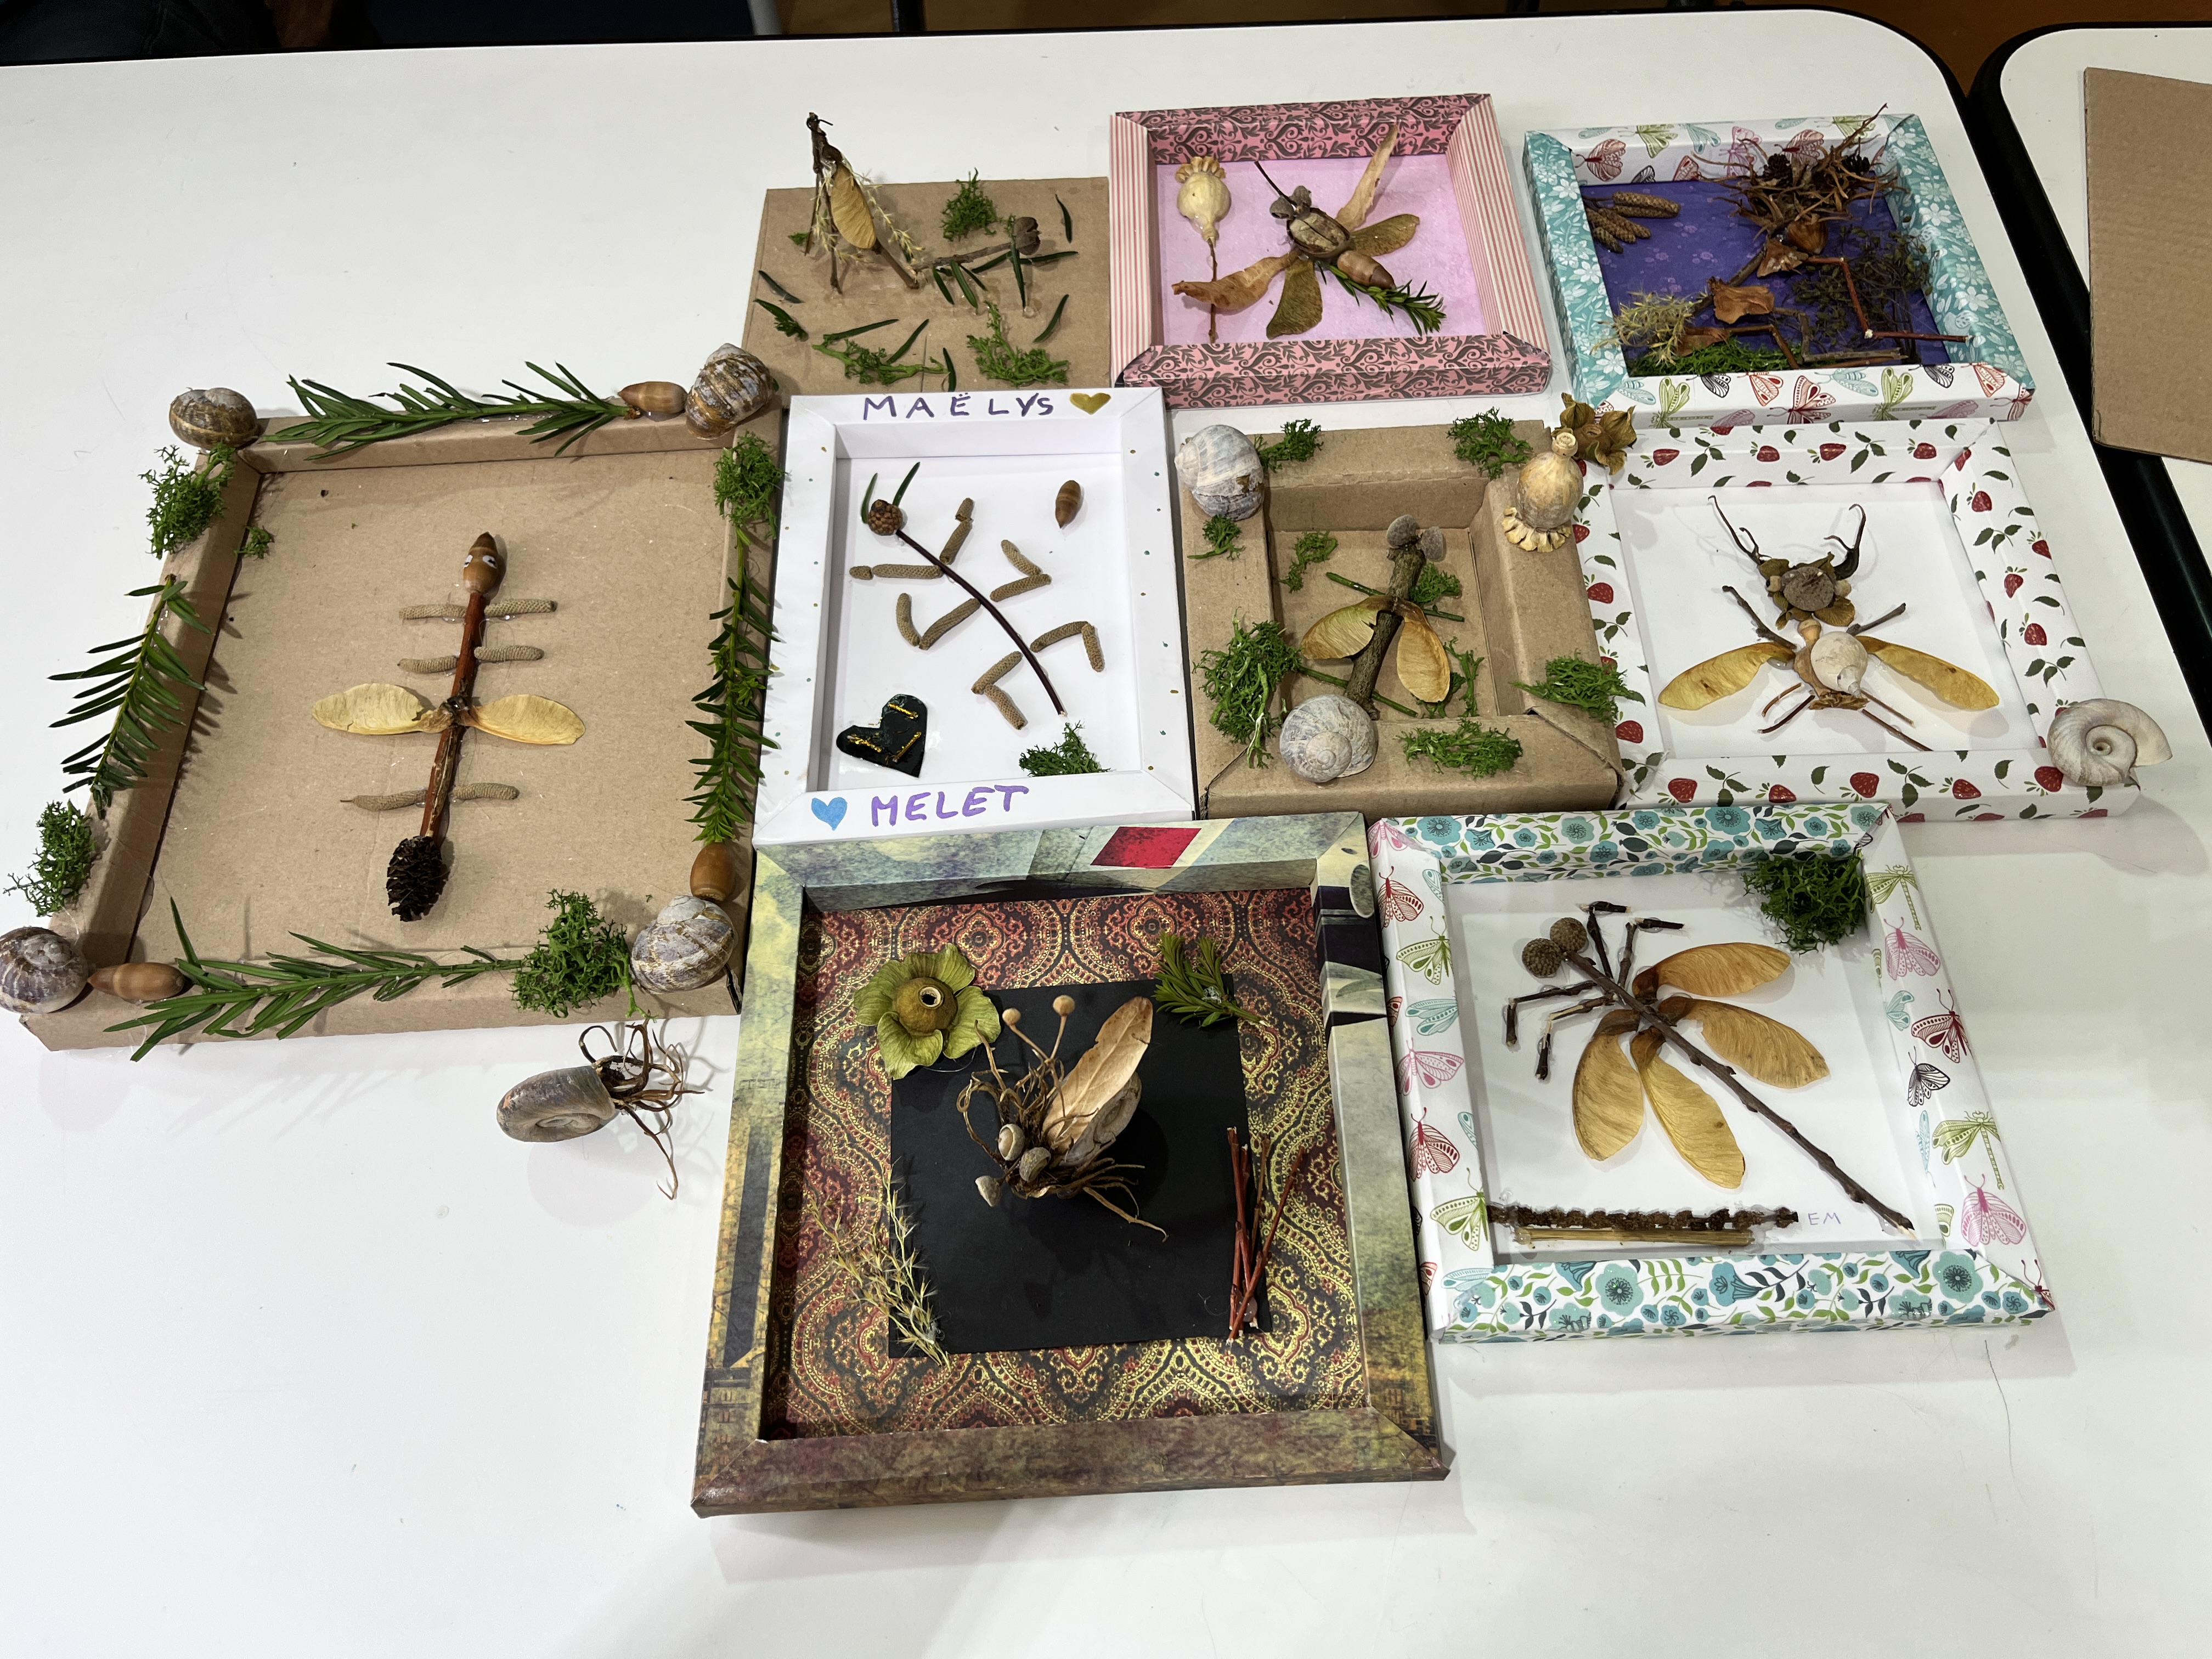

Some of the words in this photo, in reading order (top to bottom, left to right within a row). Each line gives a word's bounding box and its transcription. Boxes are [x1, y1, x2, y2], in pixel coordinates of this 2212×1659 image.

[863, 393, 1054, 420] MAËLYS
[871, 785, 1030, 827] MELET
[1808, 1212, 1841, 1225] EM
